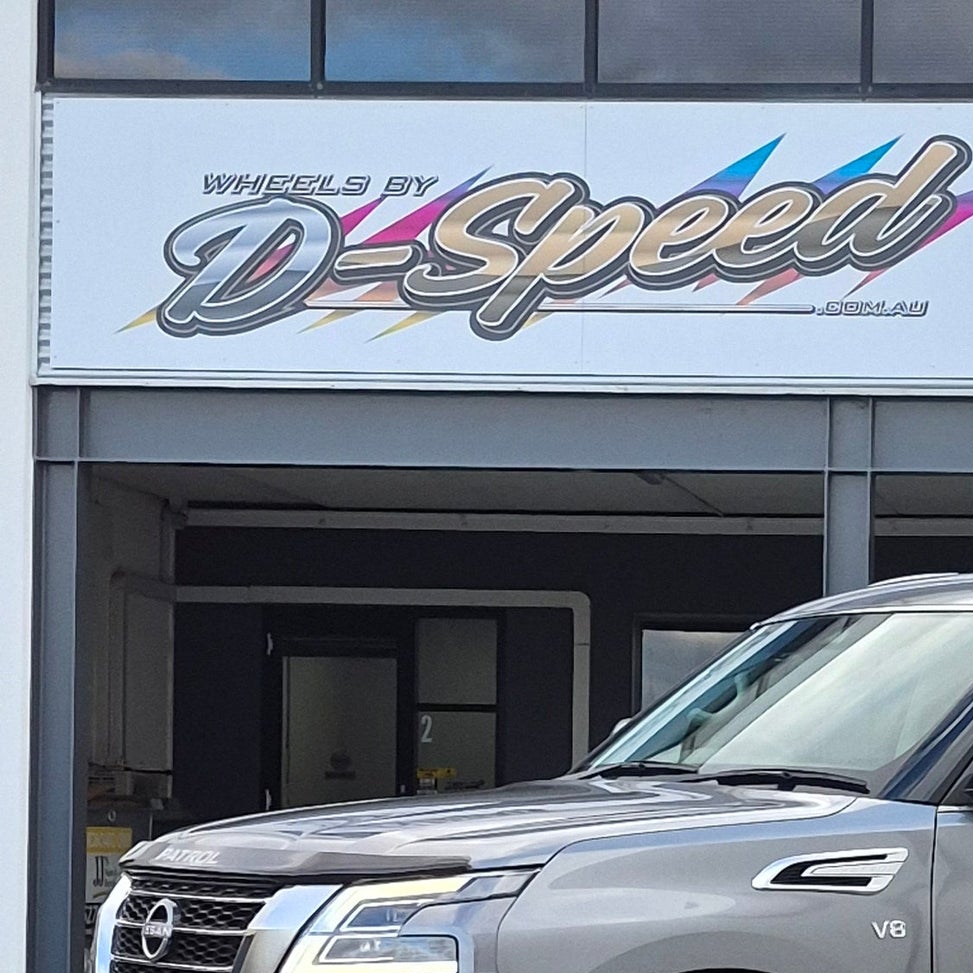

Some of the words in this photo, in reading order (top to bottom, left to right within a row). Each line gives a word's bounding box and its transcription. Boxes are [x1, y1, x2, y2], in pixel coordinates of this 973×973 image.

[202, 172, 368, 196] WHEELS
[381, 175, 438, 197] BY
[156, 134, 973, 341] D-Speed
[815, 300, 929, 317] .COM.AU
[421, 714, 433, 743] 2
[154, 847, 221, 865] PATROL
[871, 920, 907, 939] V8
